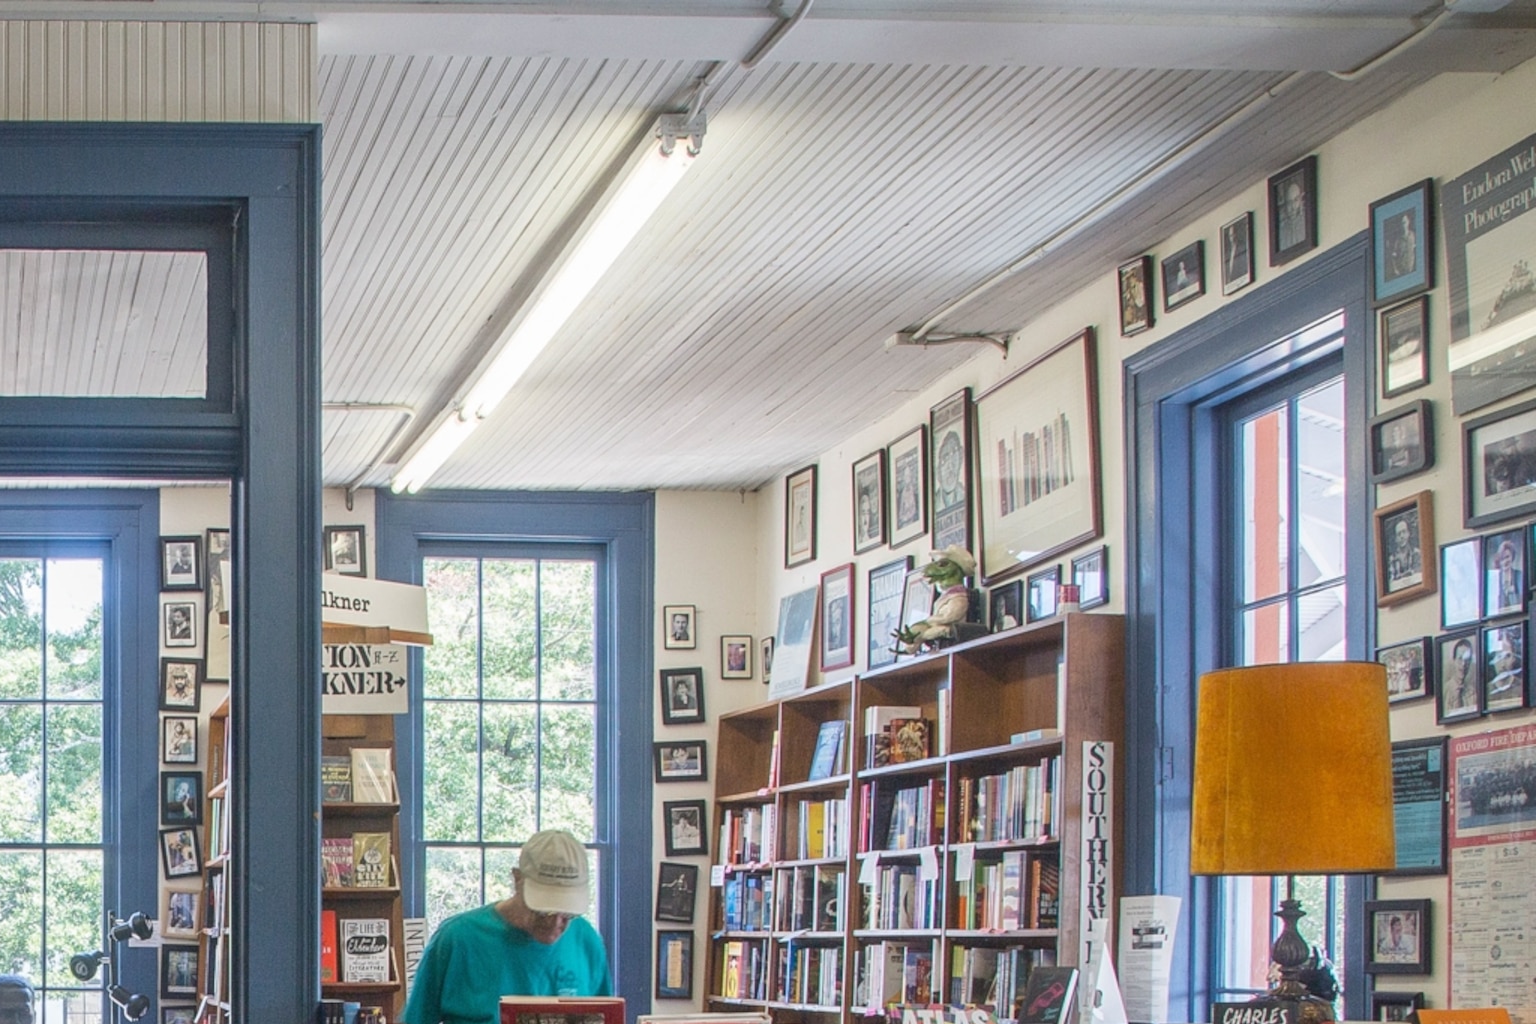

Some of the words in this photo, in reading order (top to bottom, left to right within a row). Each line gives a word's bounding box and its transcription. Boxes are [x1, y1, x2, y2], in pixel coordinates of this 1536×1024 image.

[1463, 169, 1511, 205] Eudora
[321, 590, 371, 612] lkner
[1490, 735, 1509, 747] FIRE
